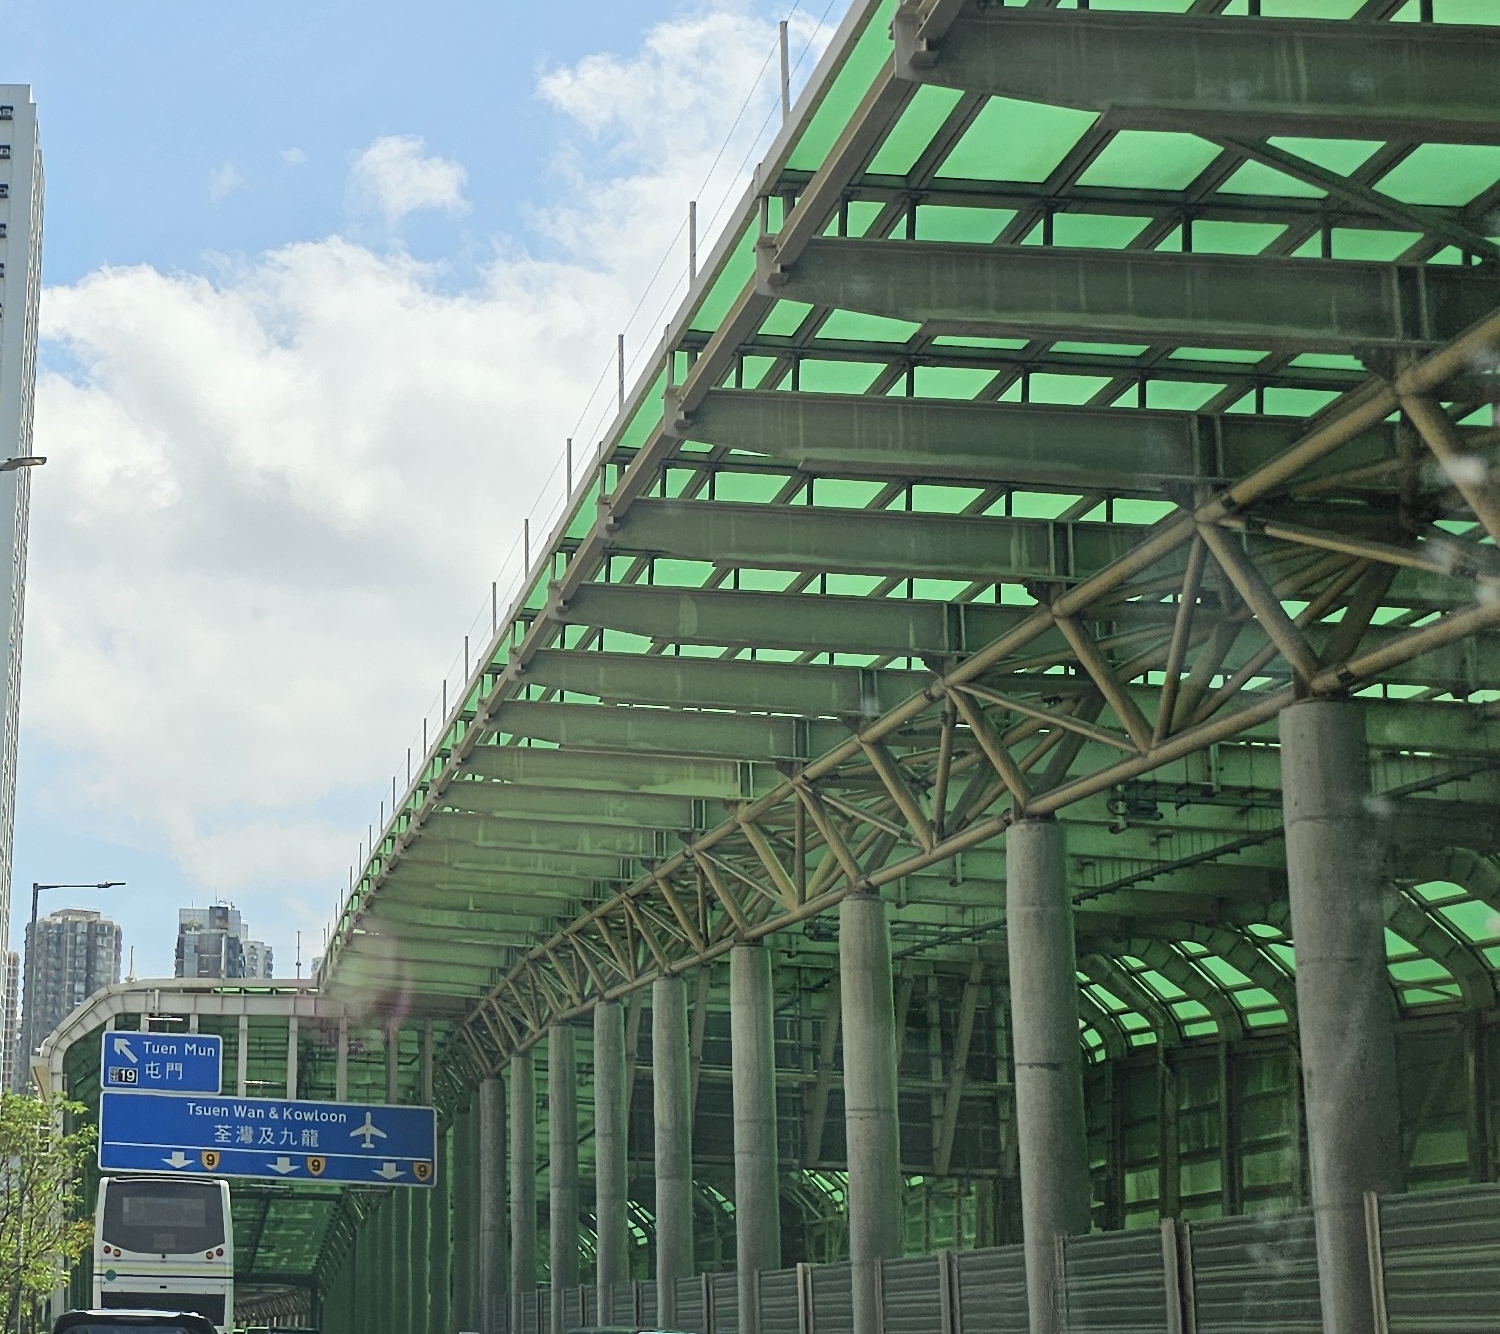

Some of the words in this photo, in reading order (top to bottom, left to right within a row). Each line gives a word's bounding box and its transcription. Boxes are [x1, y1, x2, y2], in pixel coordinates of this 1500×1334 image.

[142, 1041, 177, 1055] Tuen
[184, 1043, 215, 1057] Mun
[120, 1069, 136, 1082] 19
[145, 1061, 183, 1080] 屯門
[187, 1103, 229, 1117] Tsuen
[233, 1105, 265, 1119] Wan
[269, 1107, 279, 1120] &
[283, 1107, 347, 1124] Kowloon
[214, 1124, 319, 1148] 荃灣及九龍
[206, 1153, 215, 1165] 9
[311, 1158, 321, 1171] 9
[418, 1164, 427, 1177] 9
